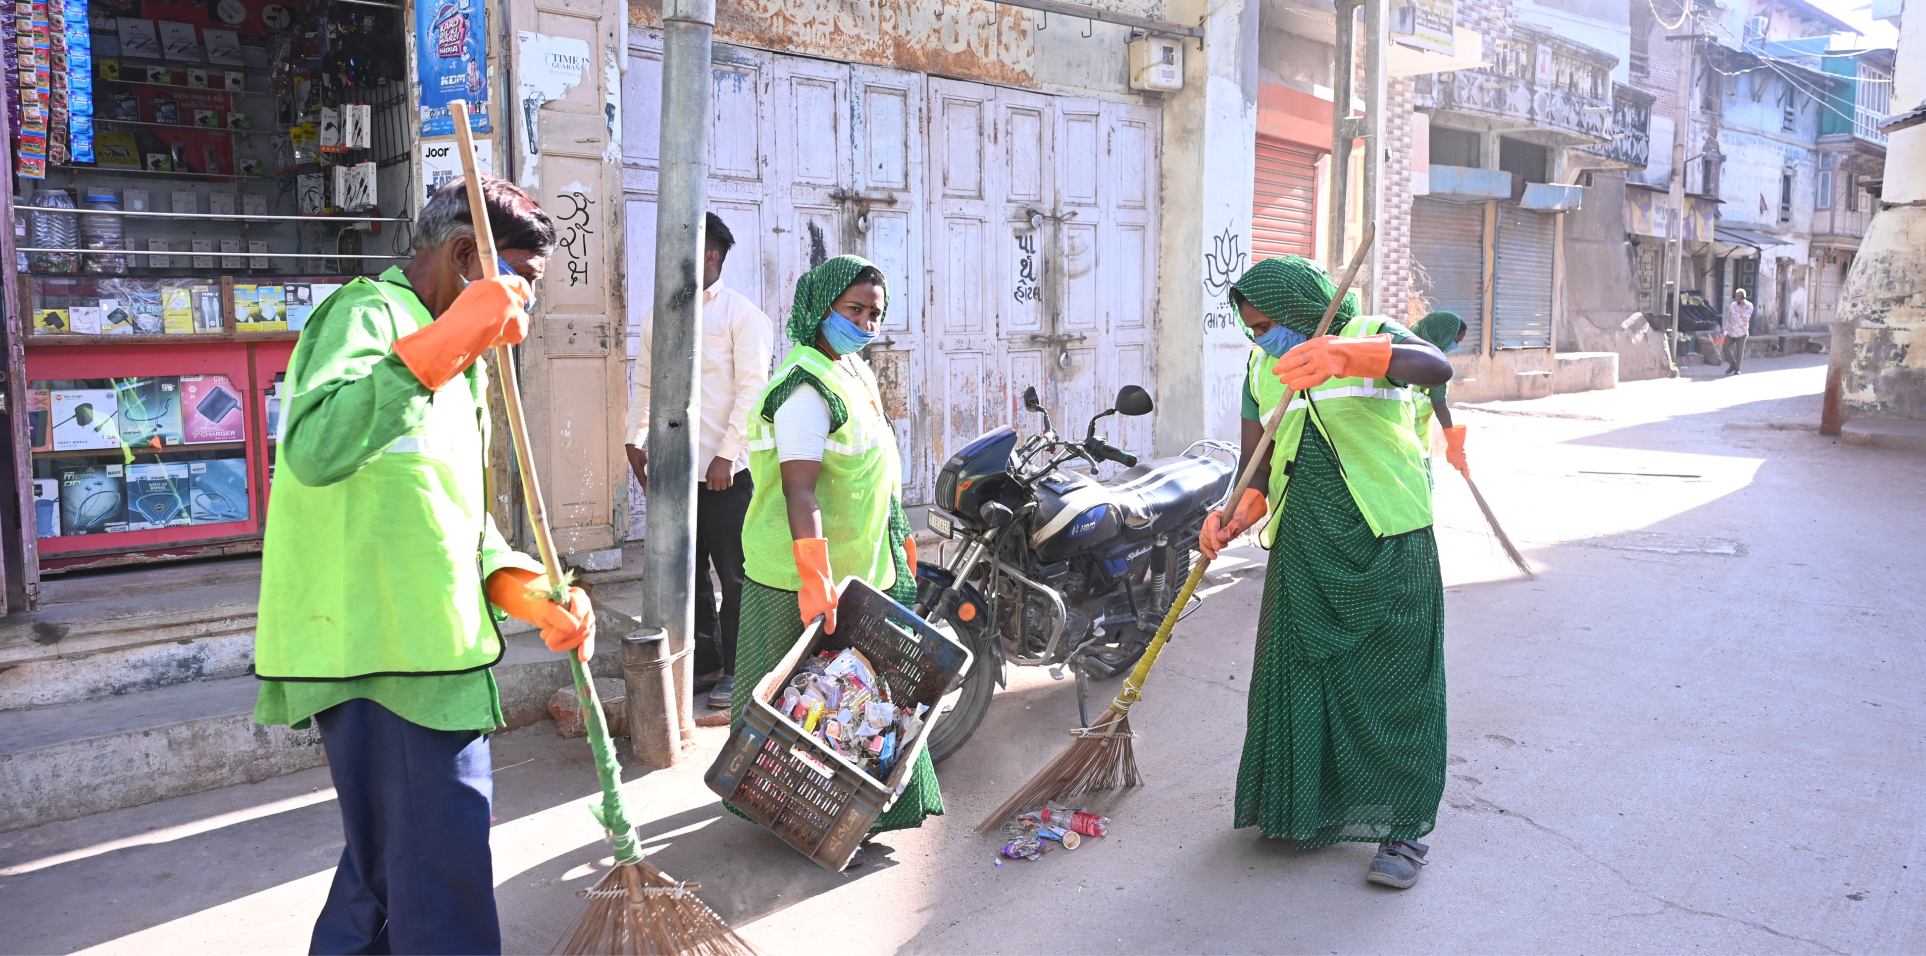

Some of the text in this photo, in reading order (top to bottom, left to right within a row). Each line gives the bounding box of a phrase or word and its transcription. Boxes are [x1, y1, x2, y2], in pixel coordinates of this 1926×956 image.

[440, 45, 459, 55] INDIA
[551, 52, 580, 66] TIME
[441, 74, 466, 86] KDM
[1203, 312, 1236, 335] ભાજપ
[200, 430, 235, 438] CHARGER
